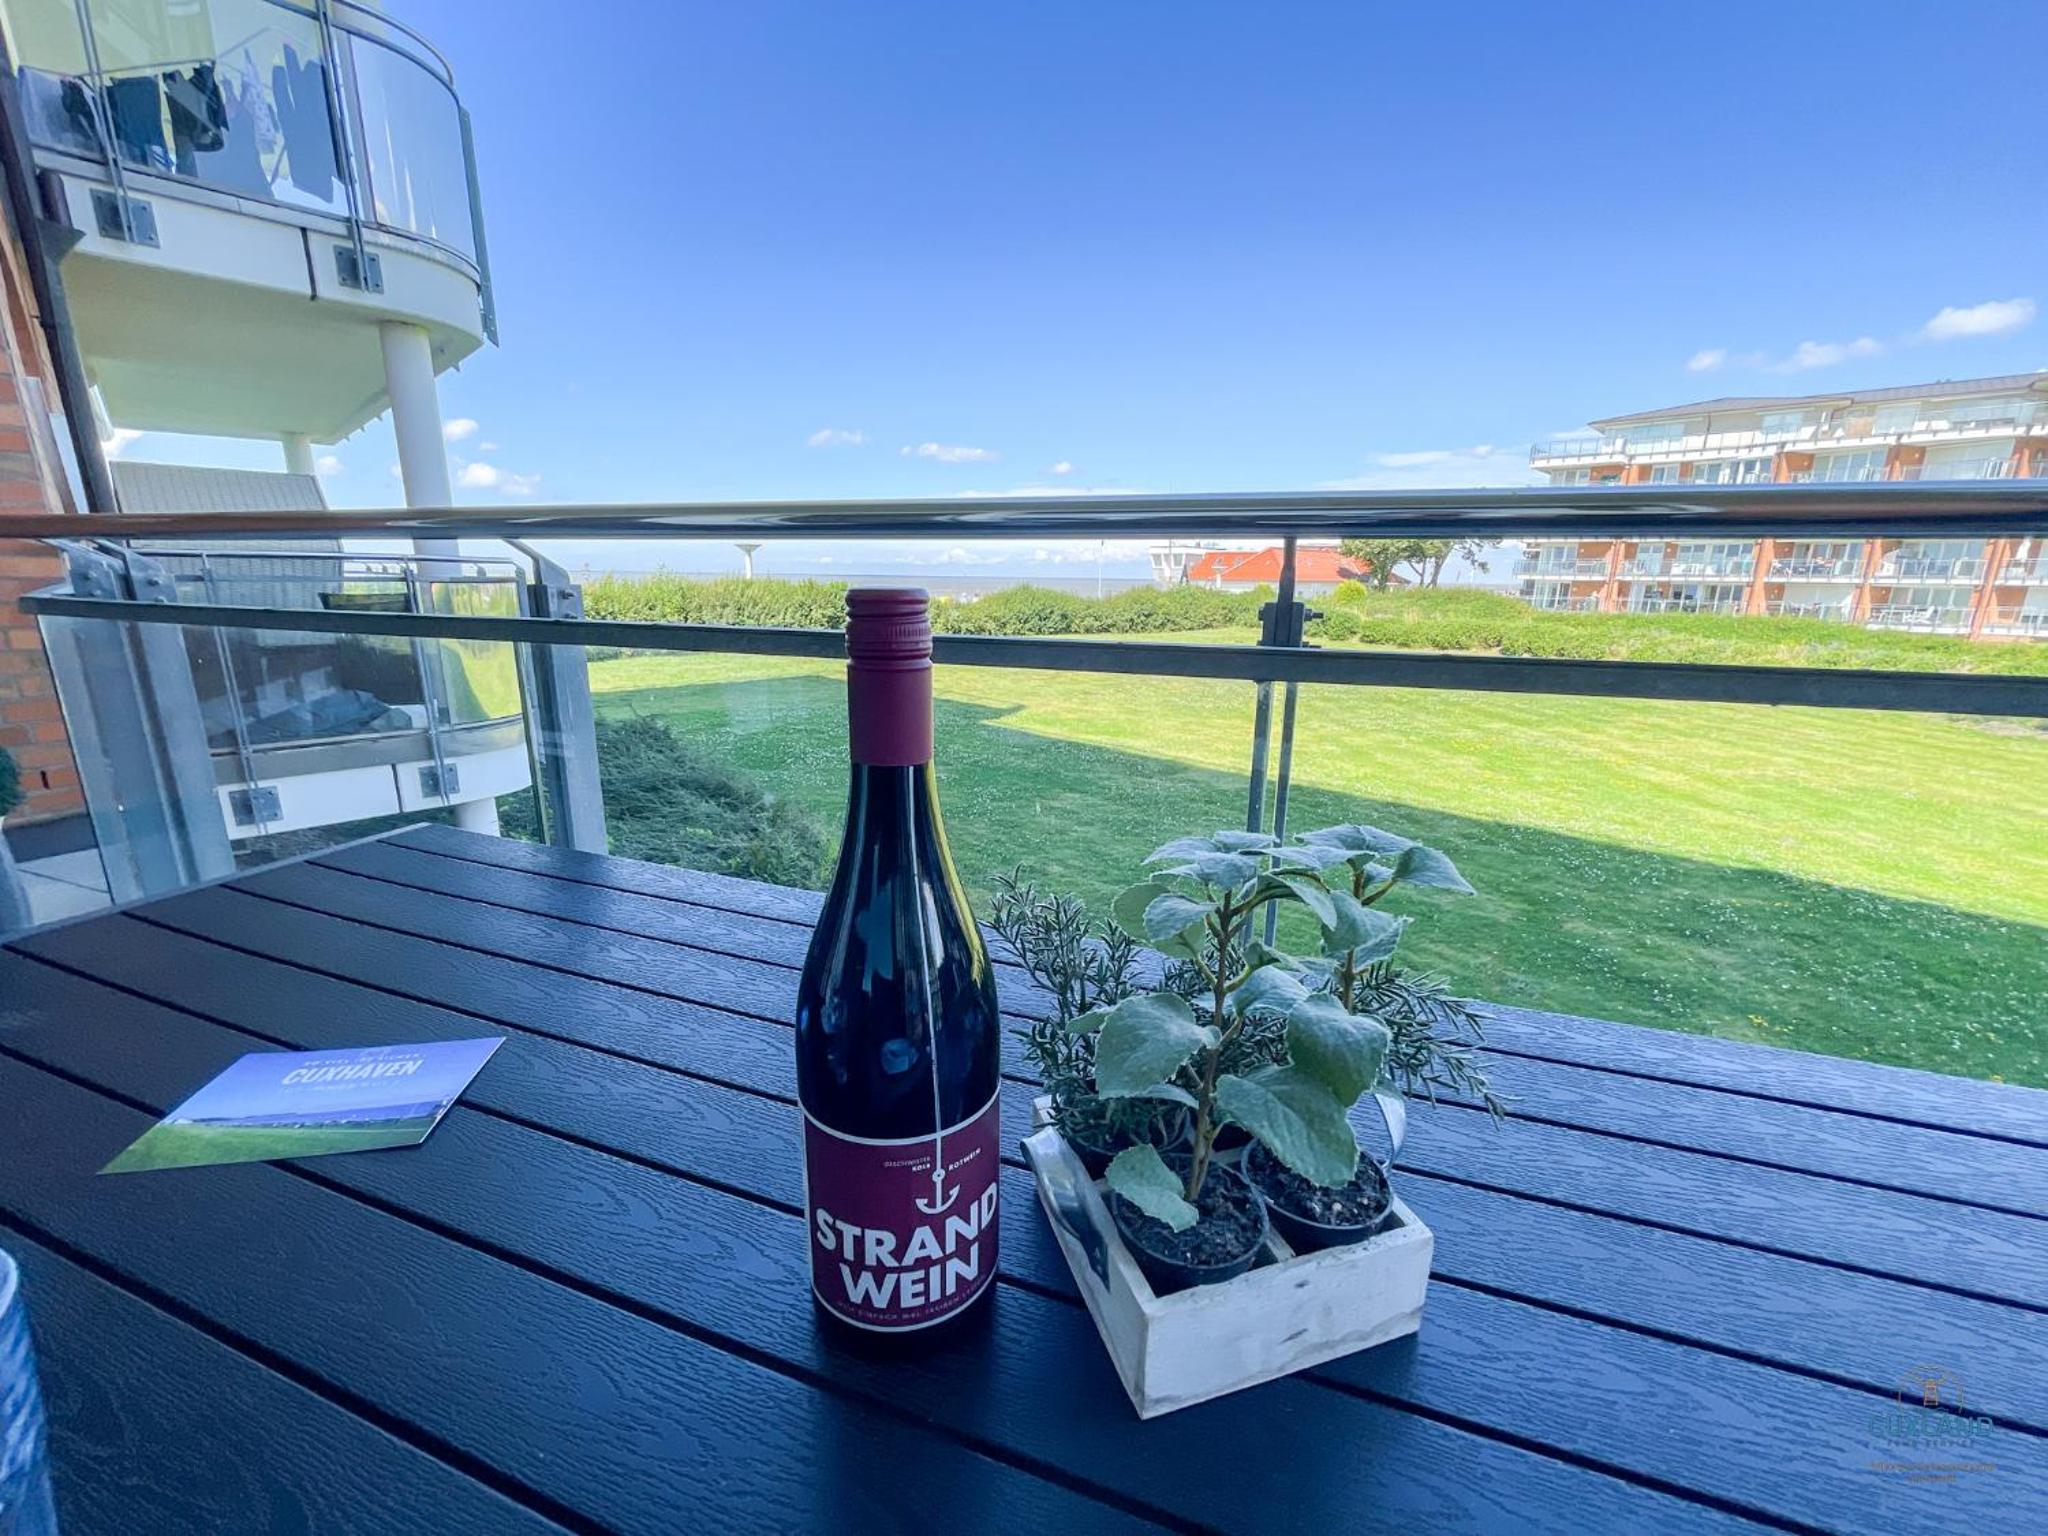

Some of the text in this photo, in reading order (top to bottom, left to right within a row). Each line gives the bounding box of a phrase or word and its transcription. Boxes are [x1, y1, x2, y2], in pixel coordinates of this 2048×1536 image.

[281, 1059, 425, 1085] CUXHAVEN
[816, 1182, 998, 1268] STRAND
[839, 1241, 979, 1309] WEIN
